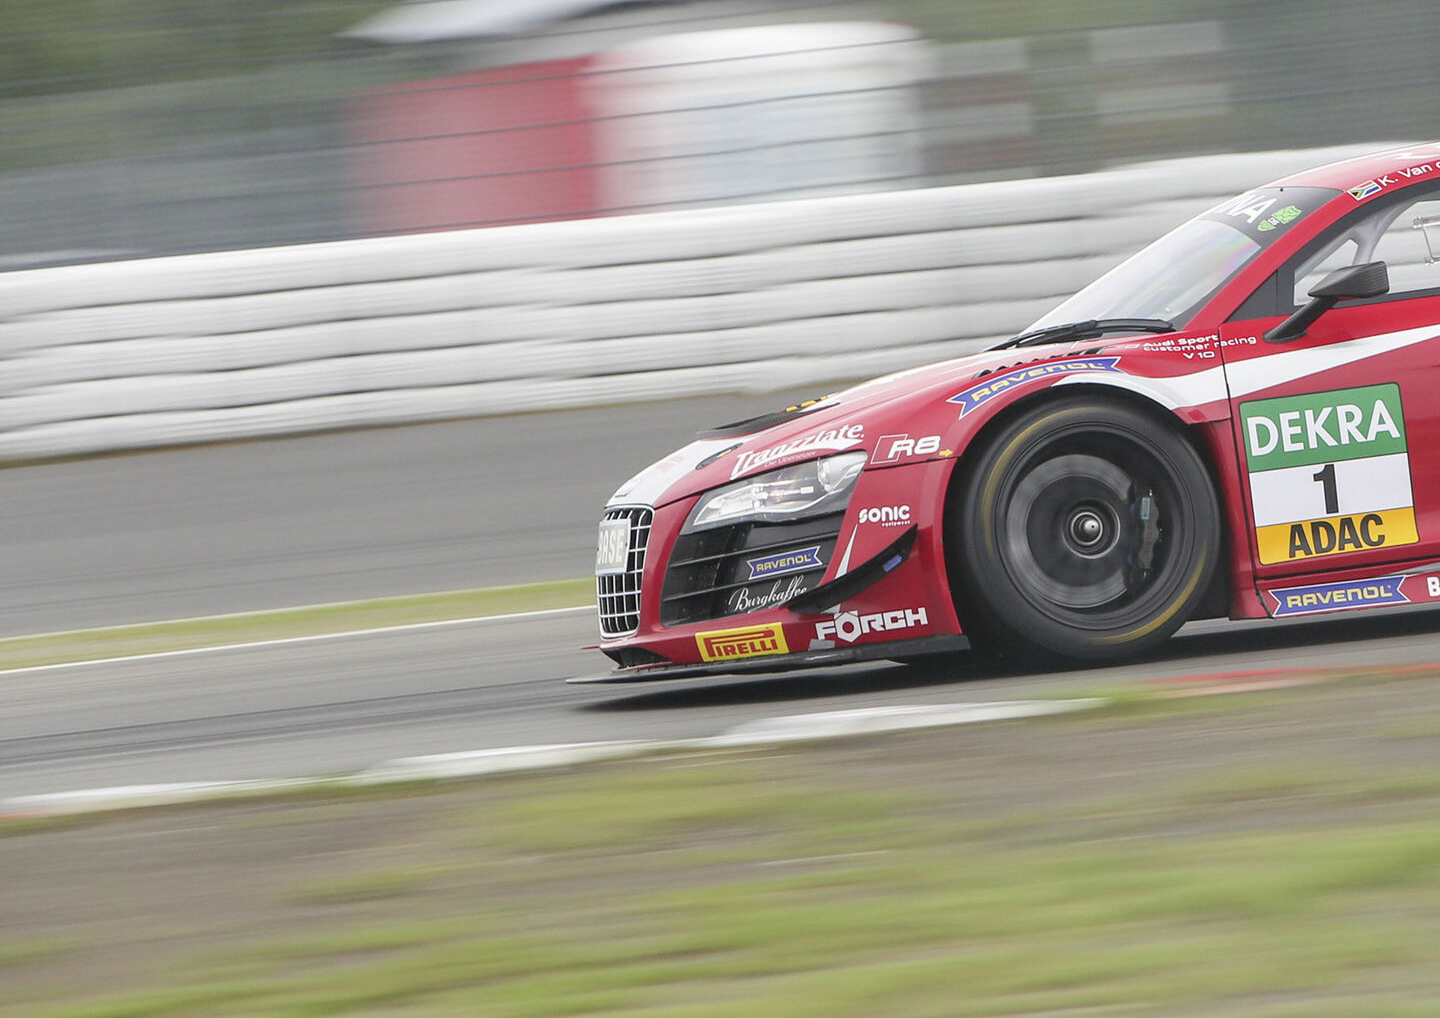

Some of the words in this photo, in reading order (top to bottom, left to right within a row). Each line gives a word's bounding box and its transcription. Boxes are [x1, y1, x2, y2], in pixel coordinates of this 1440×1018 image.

[1377, 175, 1399, 187] K.
[1398, 163, 1433, 178] Van
[1143, 339, 1175, 347] Audi
[1177, 334, 1219, 345] Sport
[1143, 343, 1210, 352] customer
[1214, 336, 1257, 348] racing
[970, 361, 1106, 402] RAVENOL
[1247, 399, 1401, 457] DEKRA
[888, 435, 941, 459] R8
[1313, 463, 1340, 515] 1
[1288, 513, 1386, 559] ADAC
[756, 554, 812, 573] RAVENOL
[1286, 584, 1393, 608] RAVENOL
[815, 606, 929, 643] FÖRCH
[703, 629, 779, 658] PIRELLI
